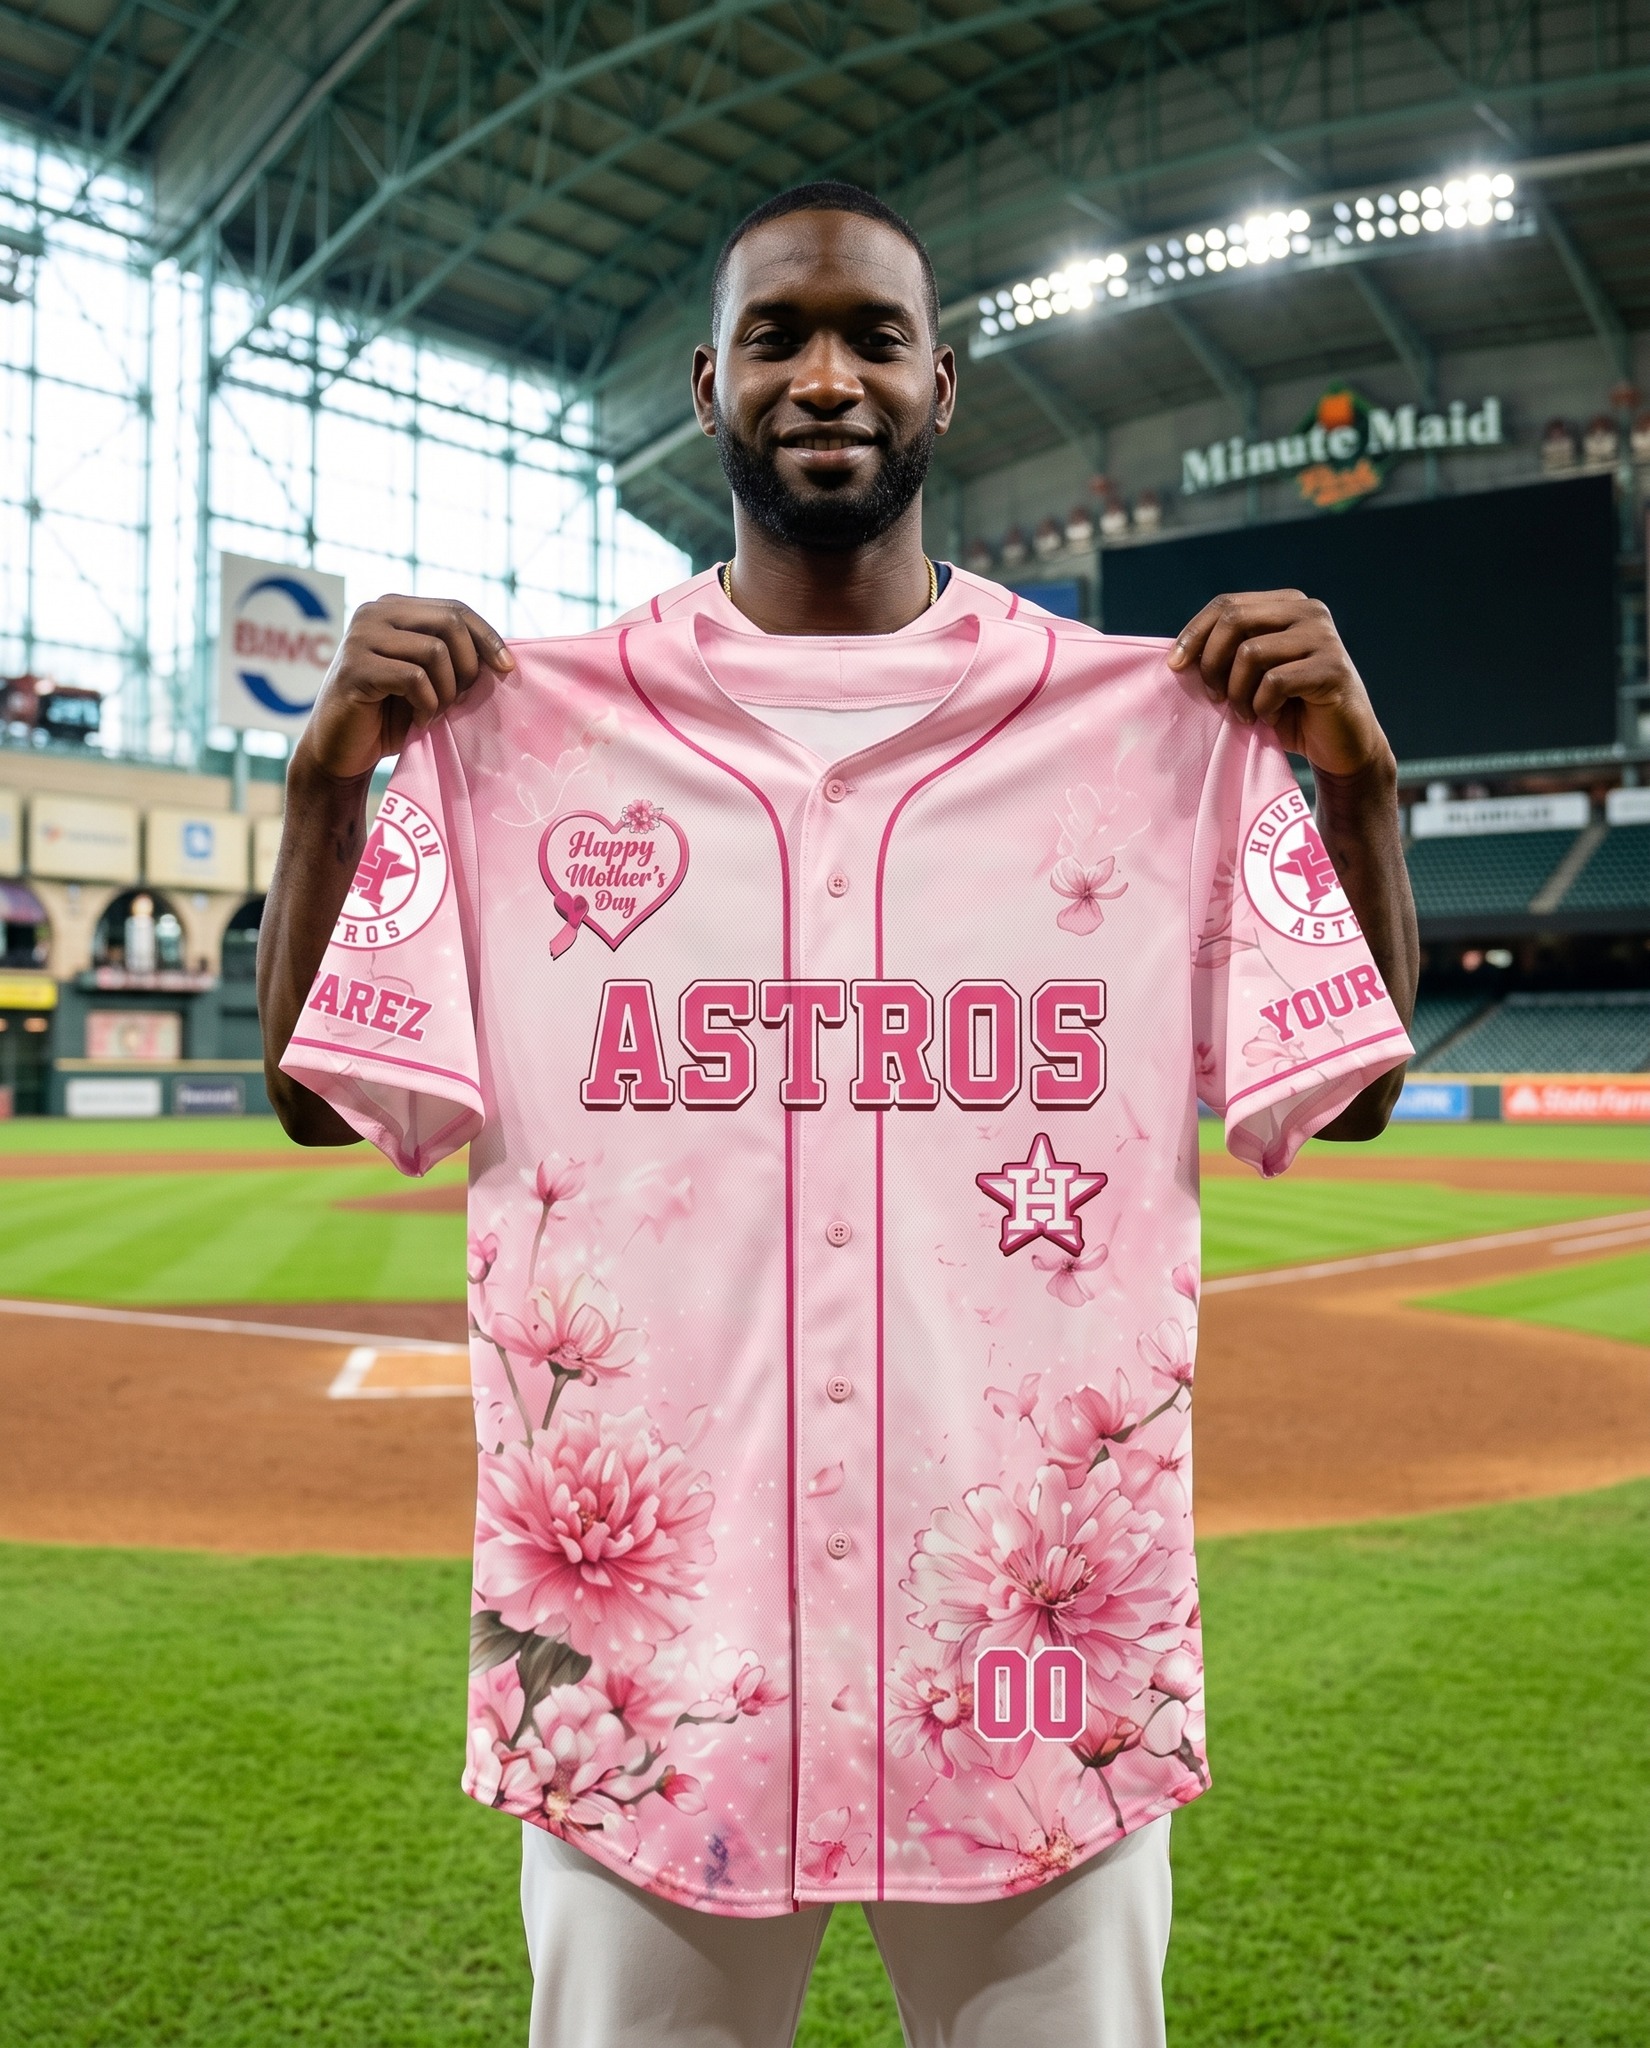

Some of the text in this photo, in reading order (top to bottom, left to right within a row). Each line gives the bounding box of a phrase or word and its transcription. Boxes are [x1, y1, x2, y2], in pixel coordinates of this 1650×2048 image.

[1182, 396, 1502, 495] Minute Maid
[565, 864, 667, 888] Mother's
[569, 830, 656, 867] Happy
[595, 889, 637, 919] Day
[336, 920, 401, 944] ROS
[307, 969, 434, 1043] AREZ
[580, 979, 1107, 1112] ASTROS
[974, 1645, 1087, 1743] 00
